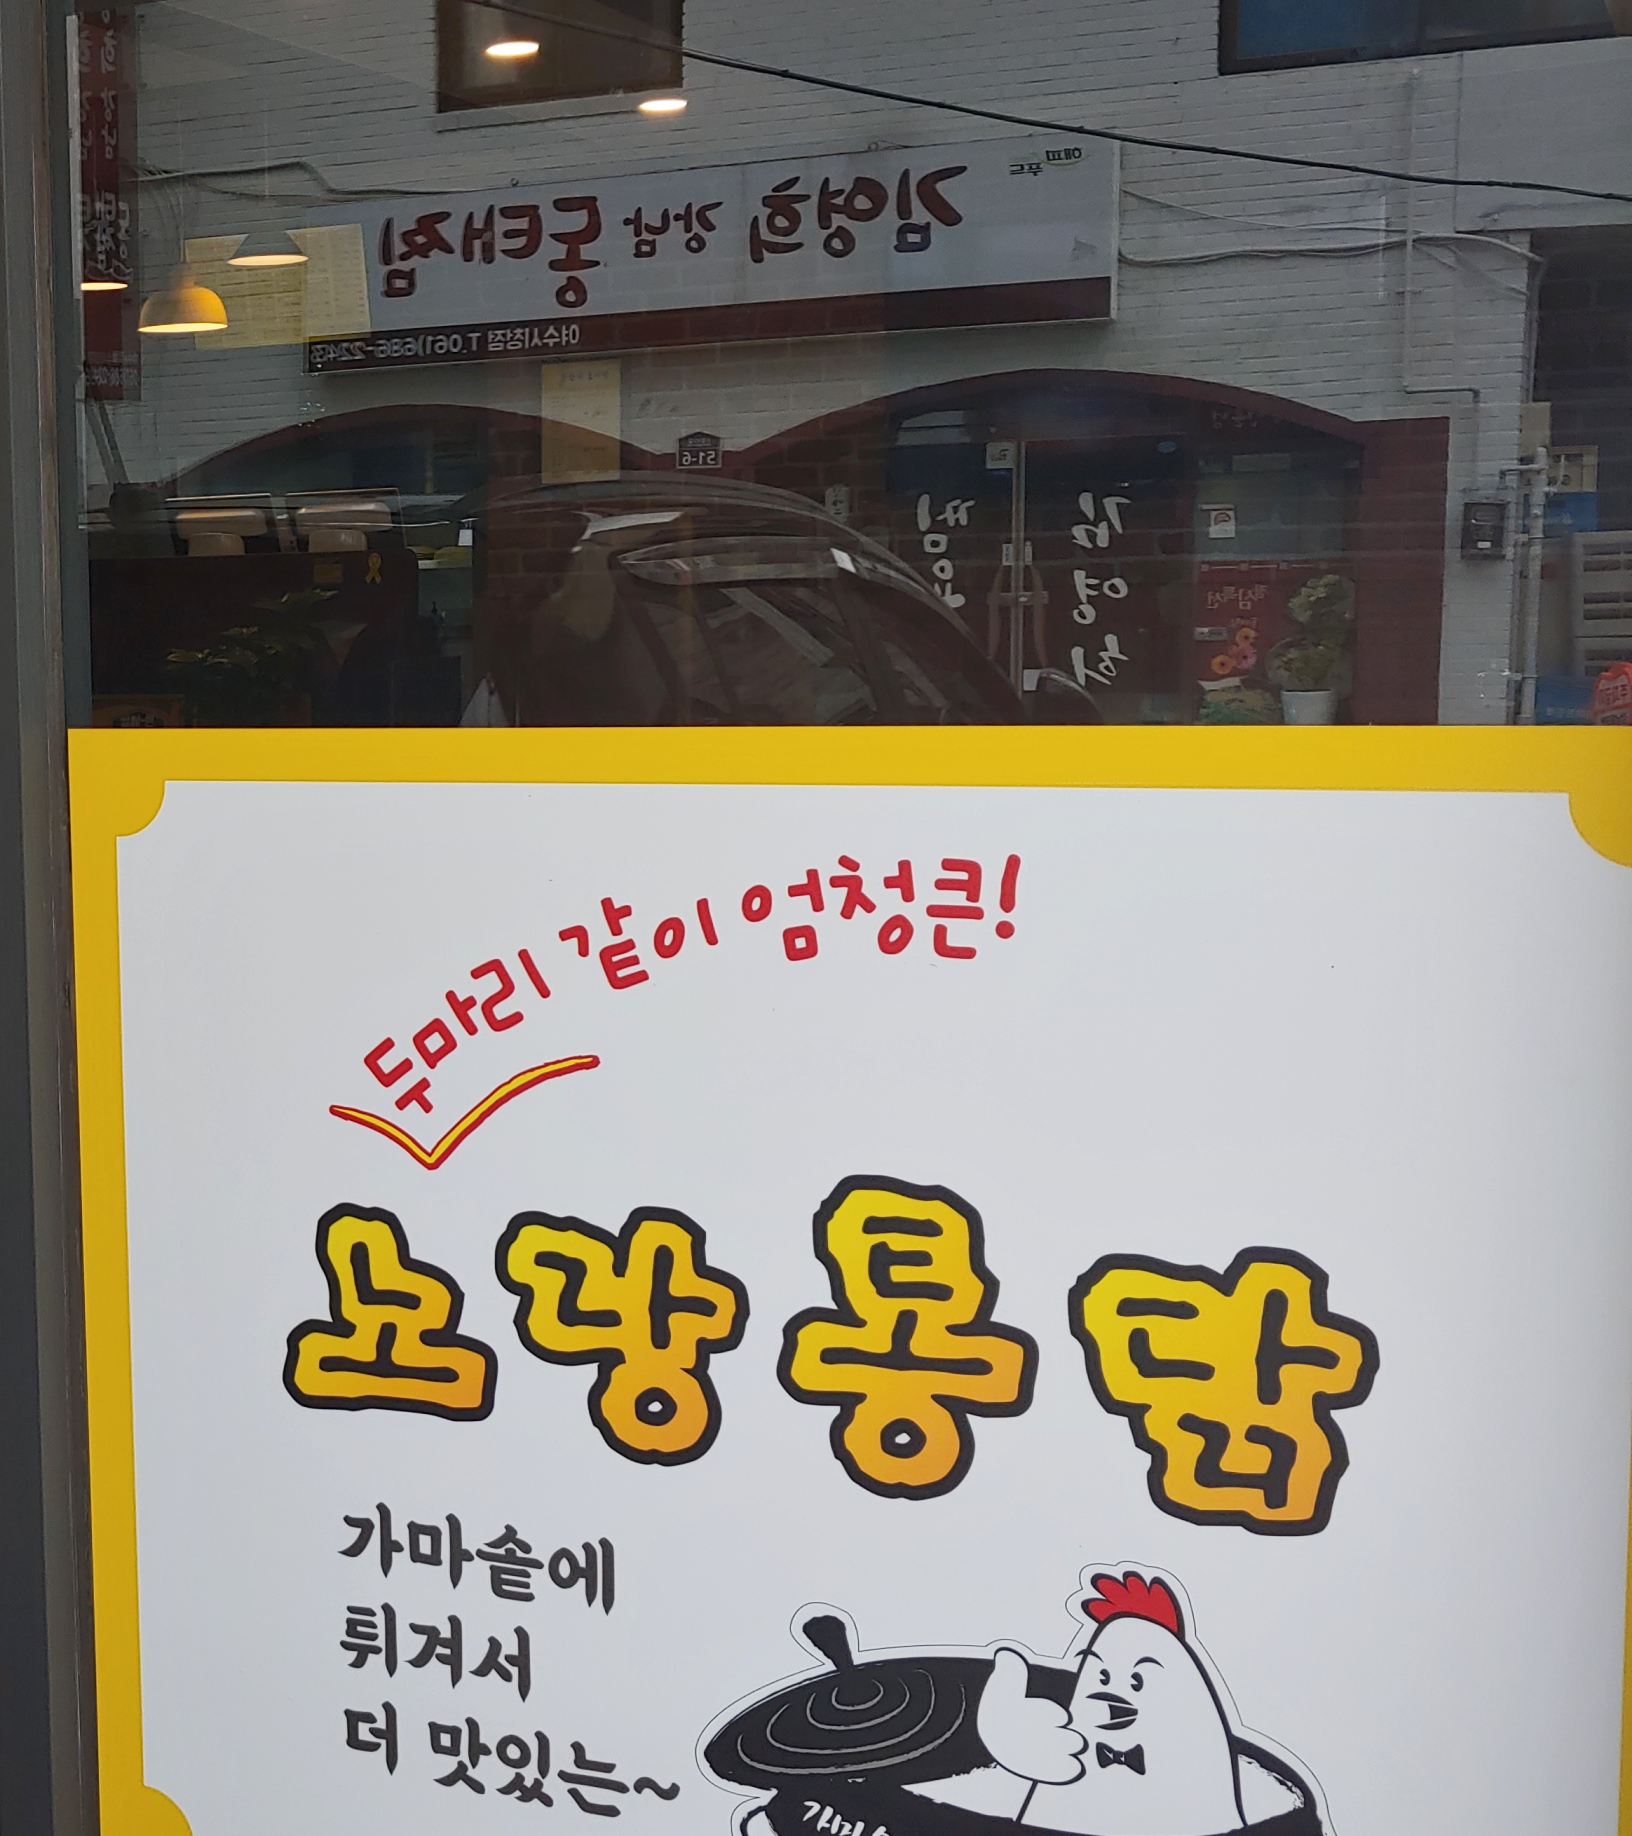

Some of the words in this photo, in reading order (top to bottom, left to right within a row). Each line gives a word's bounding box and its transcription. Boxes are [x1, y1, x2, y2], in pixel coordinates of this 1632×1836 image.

[363, 946, 551, 1114] 두마리
[558, 896, 719, 990] 같이
[740, 853, 1022, 962] 엄청큰!
[283, 1175, 1380, 1537] 노랑통닭
[337, 1502, 616, 1616] 가마솥에
[338, 1602, 531, 1703] 튀겨서
[343, 1701, 399, 1775] 더
